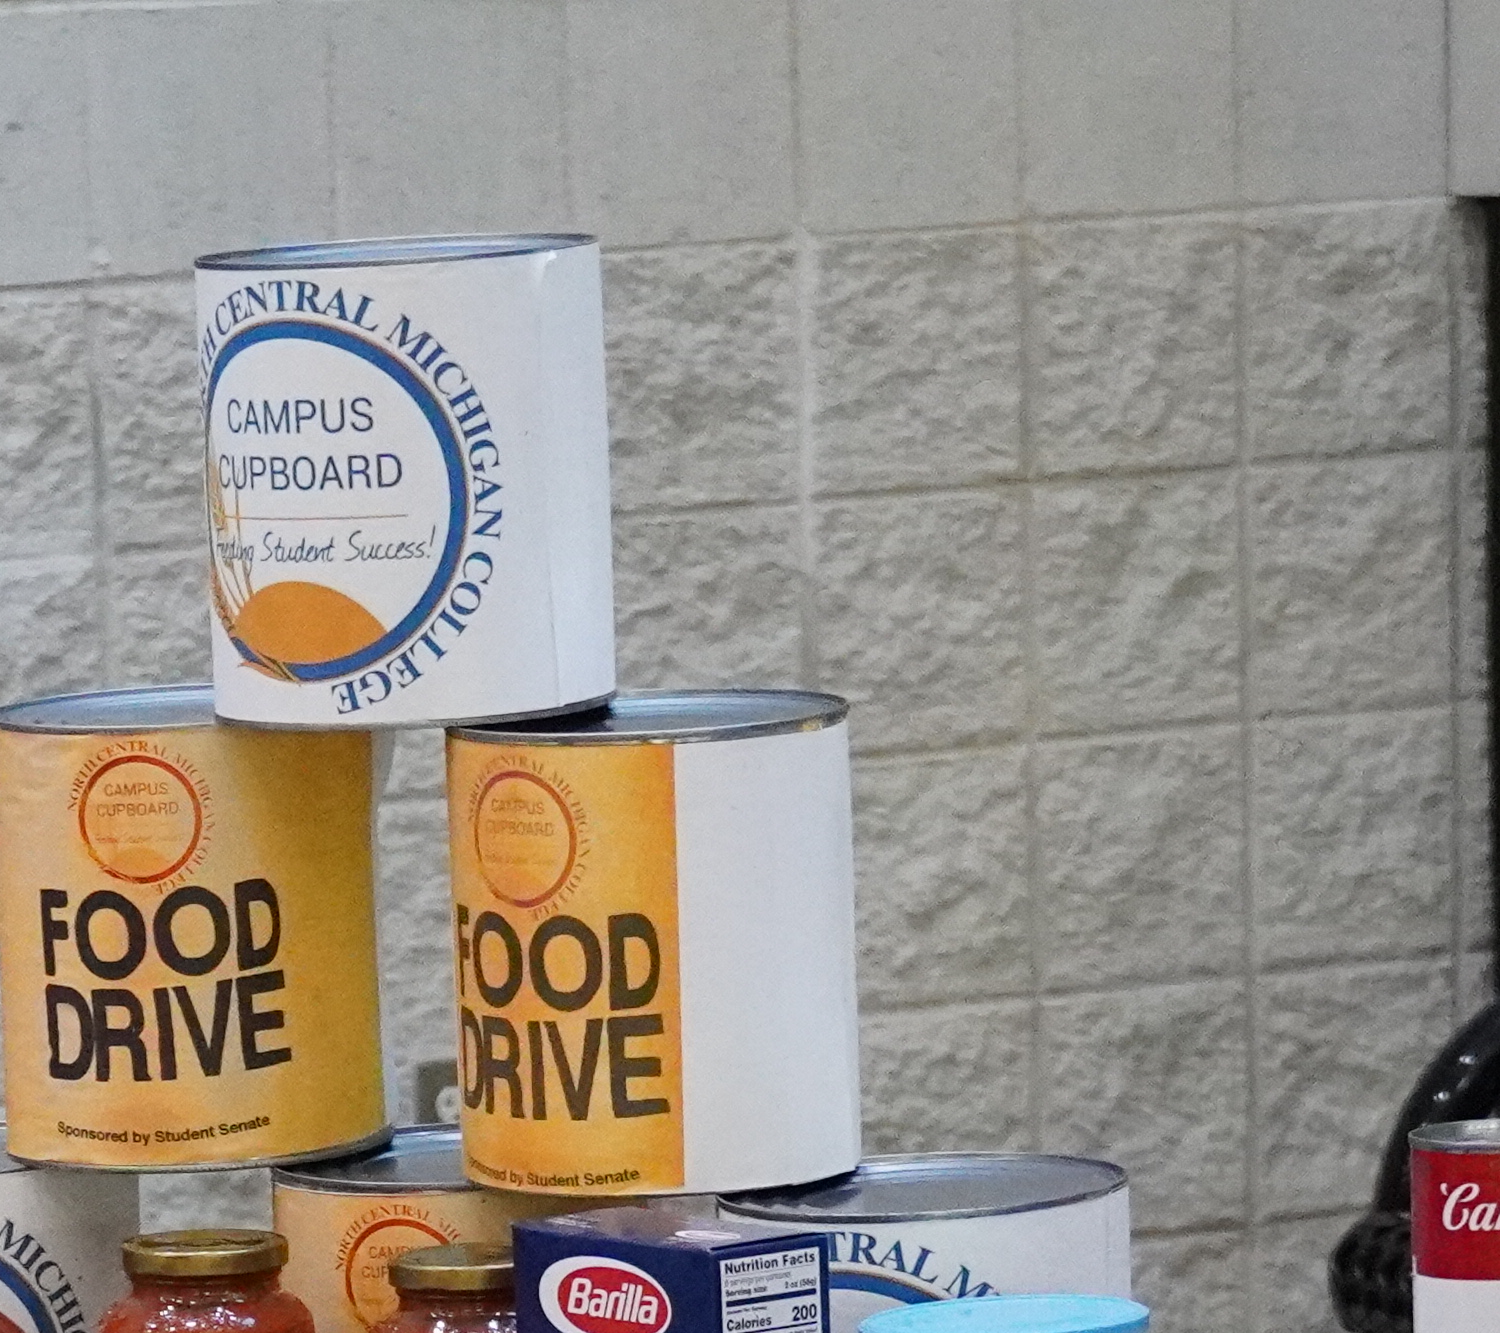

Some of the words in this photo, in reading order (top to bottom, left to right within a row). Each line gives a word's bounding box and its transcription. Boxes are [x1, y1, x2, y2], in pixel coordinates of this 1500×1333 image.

[215, 280, 378, 334] CENTRAL
[226, 396, 375, 436] CAMPUS
[385, 313, 504, 540] MICHIGAN
[218, 452, 403, 492] CUPBOARD
[259, 530, 337, 562] Student
[343, 525, 438, 562] Success!
[330, 549, 495, 715] COLLEGE
[98, 740, 168, 763] CENTRAL
[104, 781, 169, 797] CAMPUS
[96, 802, 179, 817] CUPBOARD
[39, 878, 281, 979] FOOD
[457, 902, 660, 1012] FOOD
[45, 968, 293, 1082] DRIVE
[462, 1014, 672, 1121] DRIVE
[56, 1119, 129, 1145] Sponsored
[132, 1128, 151, 1147] by
[154, 1125, 215, 1145] Student
[218, 1115, 271, 1140] Senate
[526, 1169, 581, 1188] Student
[584, 1165, 640, 1187] Senate
[725, 1256, 779, 1275] Nutrition
[782, 1251, 816, 1267] Facts
[567, 1278, 659, 1325] Barilla
[727, 1314, 772, 1331] Calories
[792, 1302, 817, 1322] 200
